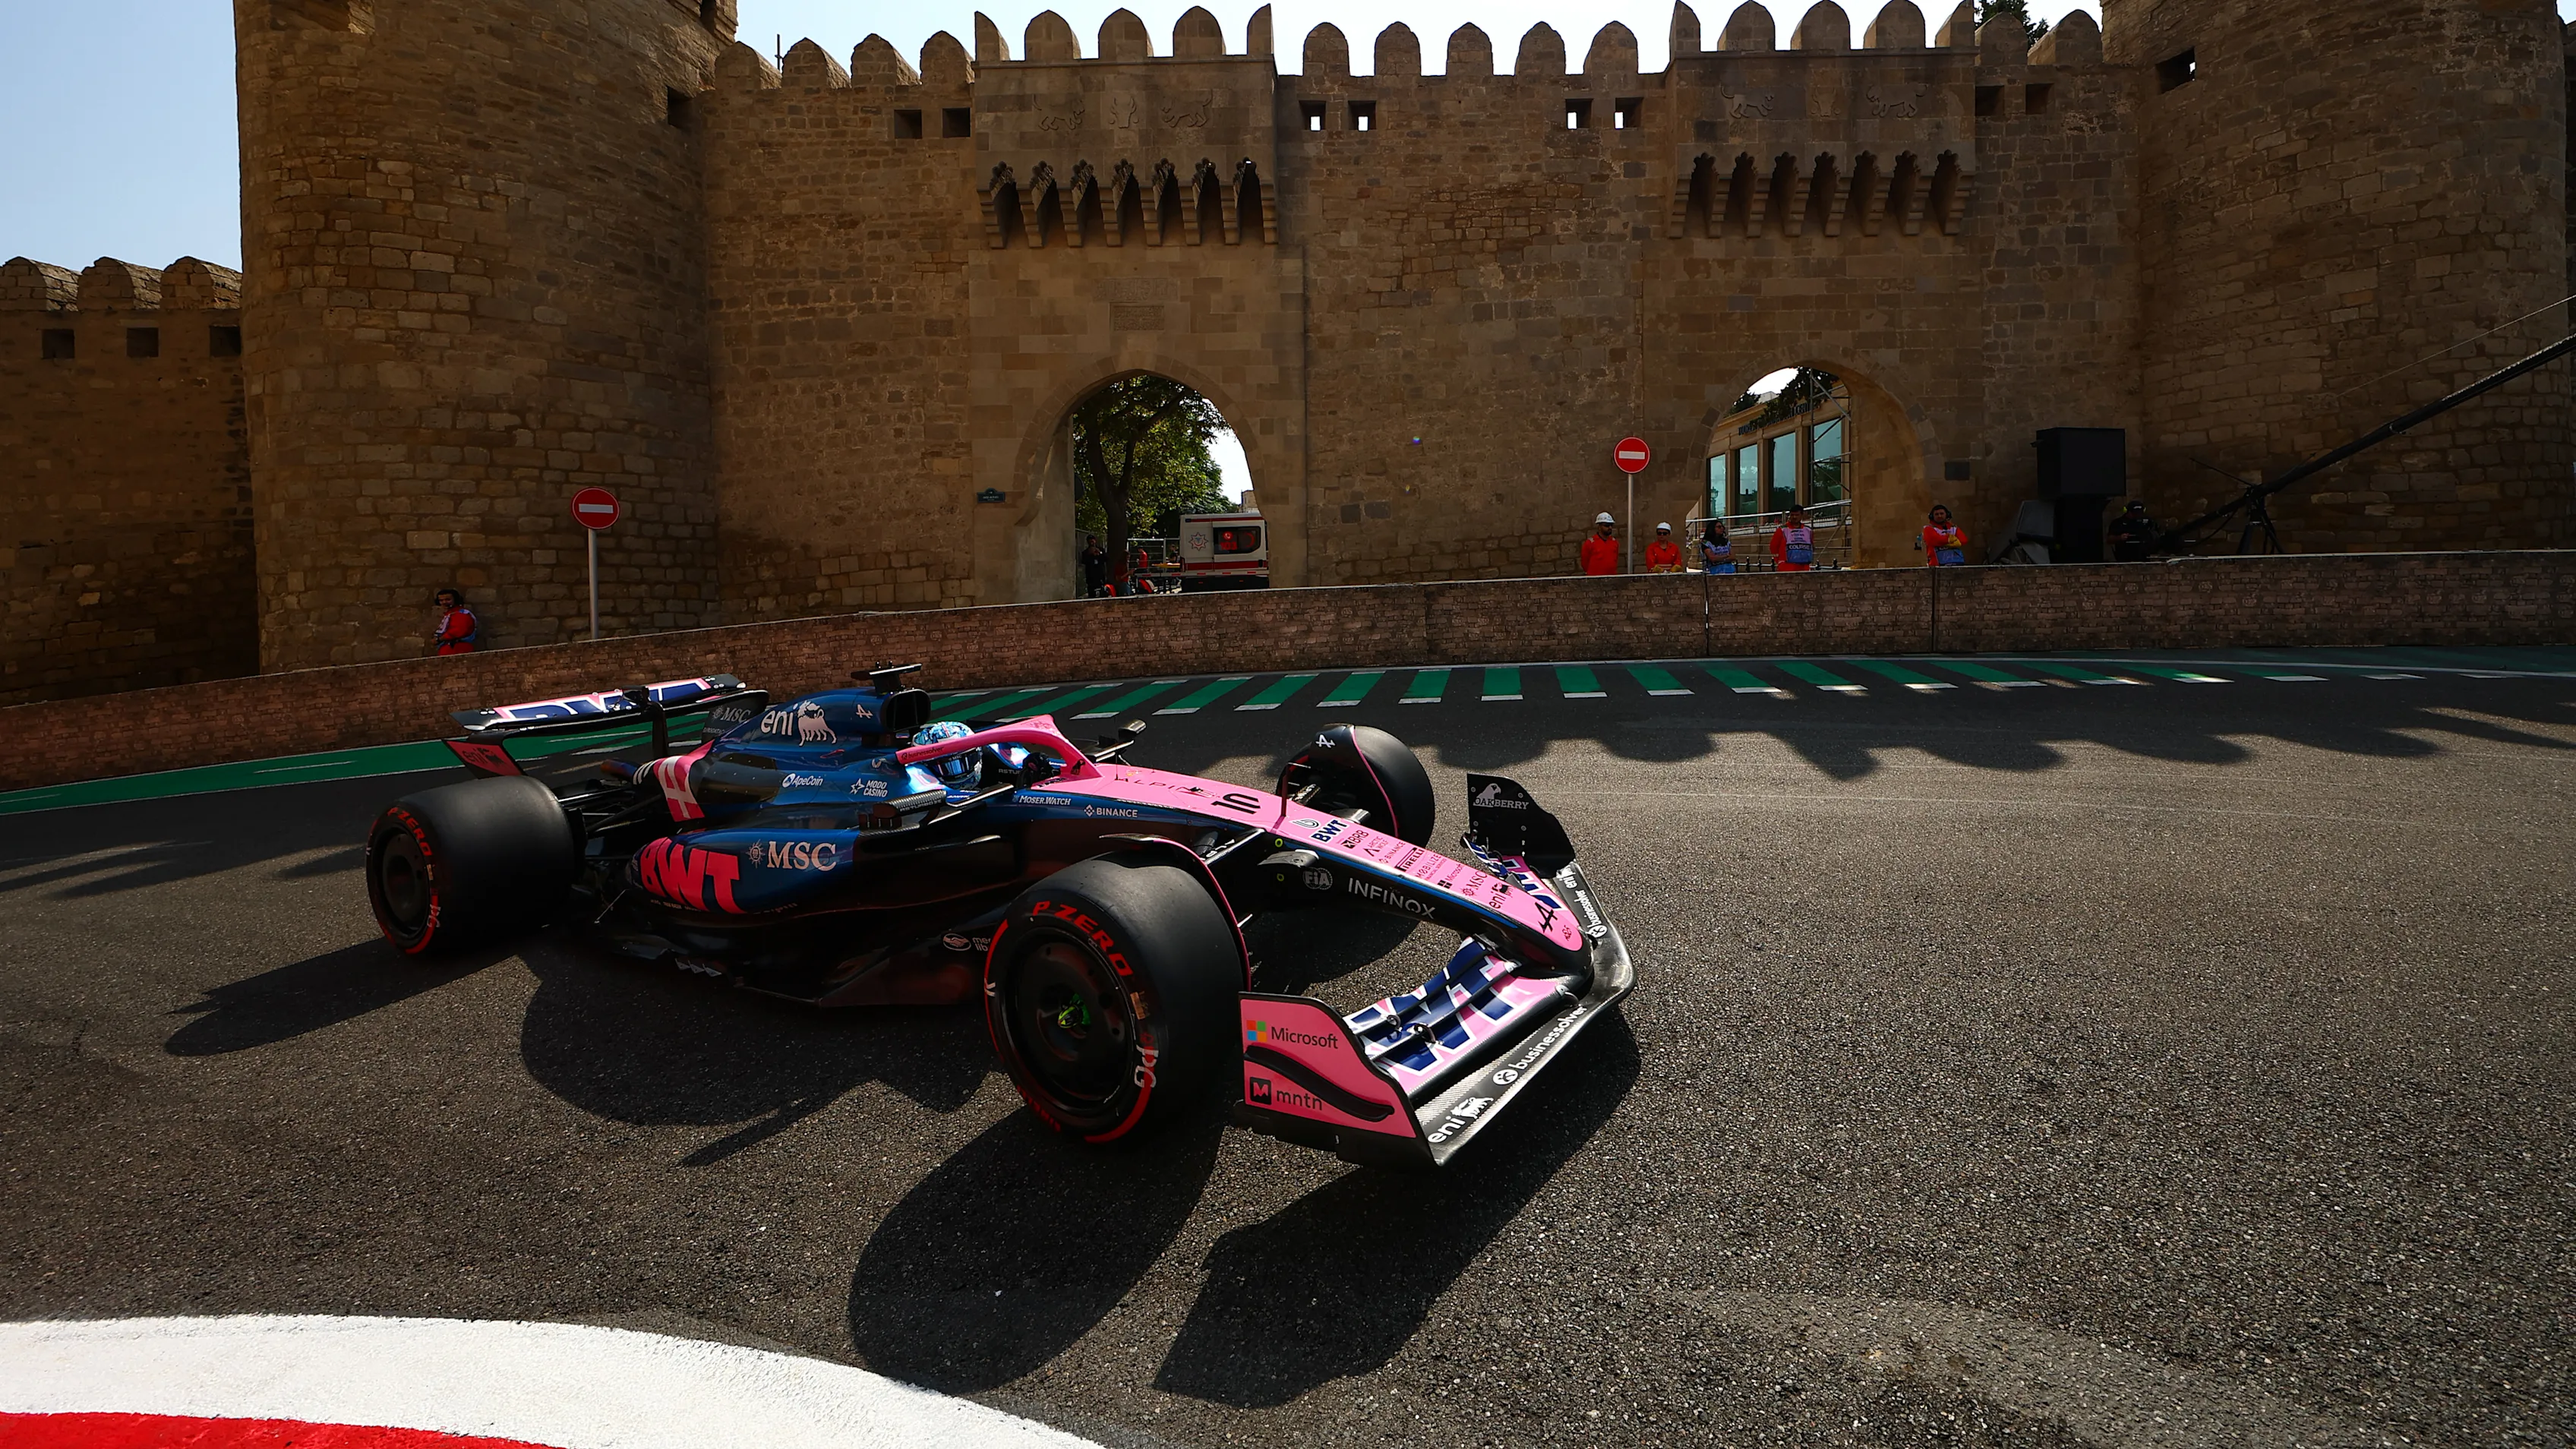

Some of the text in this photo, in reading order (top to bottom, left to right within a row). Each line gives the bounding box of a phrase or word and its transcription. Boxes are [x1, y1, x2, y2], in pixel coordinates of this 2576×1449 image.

[720, 707, 751, 723] MSC
[760, 702, 798, 735] eni
[793, 775, 824, 786] ApeCoin
[865, 780, 888, 789] MODO
[863, 788, 889, 797] CASINO
[1473, 797, 1530, 810] OAKBERRY
[1096, 807, 1138, 818] BINANCE
[398, 810, 433, 857] ZERO
[1311, 819, 1347, 842] BWT
[1348, 829, 1369, 844] BRB
[766, 841, 837, 871] MSC
[1384, 841, 1406, 860] BINANCE
[1394, 847, 1425, 872] PIRELLI
[639, 836, 747, 914] BWT
[1444, 863, 1464, 882] Microsoft
[1466, 871, 1488, 890] MSC
[1559, 874, 1578, 889] eni
[1348, 877, 1435, 920] INFINOX
[1489, 889, 1507, 909] eni
[1574, 889, 1603, 931] businessolver
[1032, 901, 1134, 977] P ZERO
[1271, 1025, 1338, 1050] Microsoft
[1507, 1002, 1588, 1070] businessolver
[1276, 1088, 1323, 1111] mntn
[1427, 1116, 1466, 1144] eni
